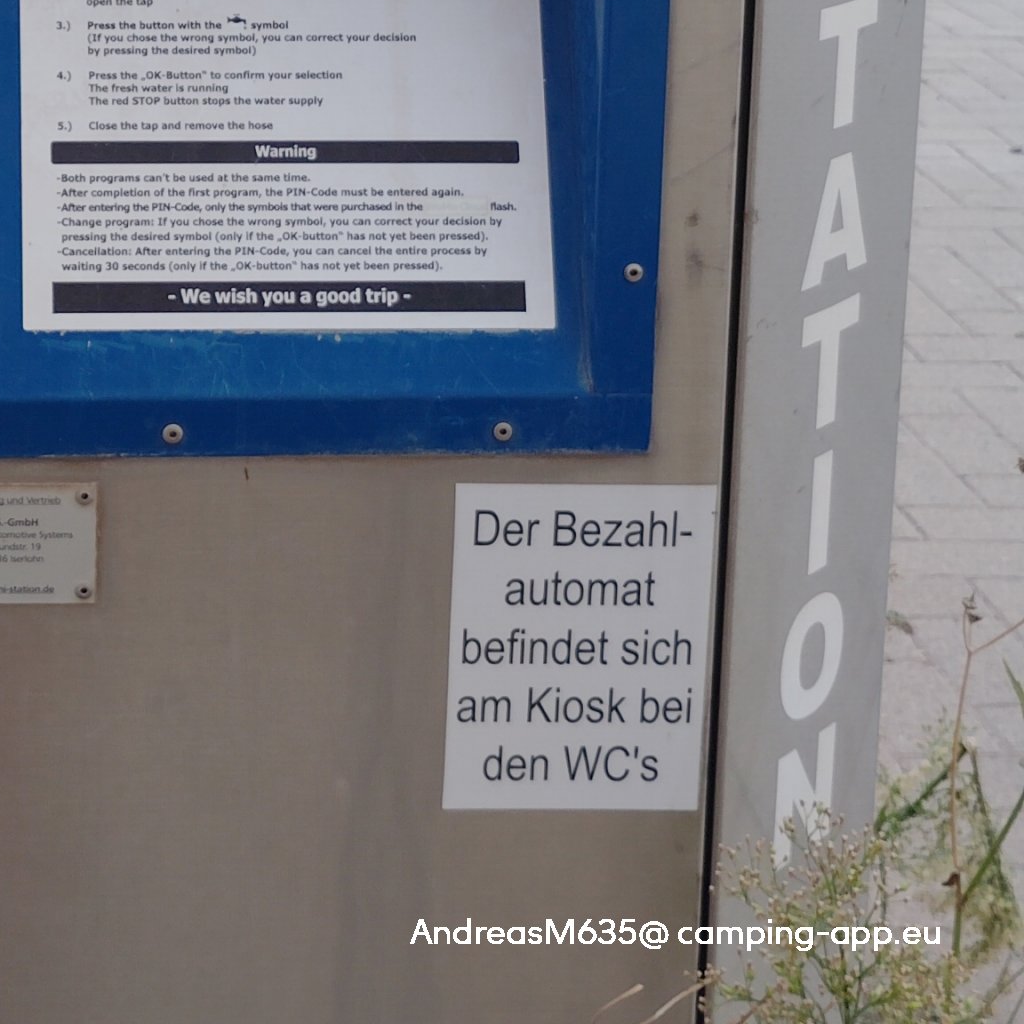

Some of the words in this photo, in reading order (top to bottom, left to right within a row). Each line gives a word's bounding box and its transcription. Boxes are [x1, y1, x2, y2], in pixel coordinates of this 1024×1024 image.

[89, 95, 108, 106] The
[112, 95, 129, 106] red
[132, 95, 160, 106] STOP
[163, 95, 199, 106] button
[202, 96, 231, 108] stops
[234, 95, 251, 106] the
[254, 96, 285, 106] water
[289, 95, 323, 108] supply
[58, 120, 72, 133] 5.)
[89, 120, 117, 131] Close
[120, 120, 138, 131] the
[141, 121, 159, 133] tap
[161, 120, 181, 131] and
[185, 122, 224, 131] remove
[227, 120, 245, 131] the
[248, 120, 273, 131] hose
[255, 144, 317, 160] Warning
[89, 174, 140, 185] programs
[143, 173, 170, 183] can't
[173, 172, 186, 183] be
[189, 172, 214, 183] used
[217, 173, 228, 183] at
[231, 172, 249, 183] the
[252, 174, 280, 183] same
[283, 172, 310, 183] time.
[181, 288, 211, 304] We
[215, 288, 258, 304] wish
[262, 291, 296, 307] you
[300, 291, 312, 304] a
[316, 287, 361, 307] good
[365, 287, 399, 307] trip
[7, 496, 24, 506] und
[27, 496, 61, 506] Vertrieb
[39, 530, 73, 541] Systems
[474, 510, 540, 547] Der
[553, 511, 692, 547] Bezahl-
[31, 542, 41, 552] 19
[505, 571, 655, 606] automat
[462, 628, 608, 665] befindet
[621, 630, 692, 666] sich
[457, 696, 511, 723] am
[527, 687, 625, 723] Kiosk
[640, 688, 692, 724] bei
[483, 745, 548, 781] den
[564, 746, 658, 782] WC's
